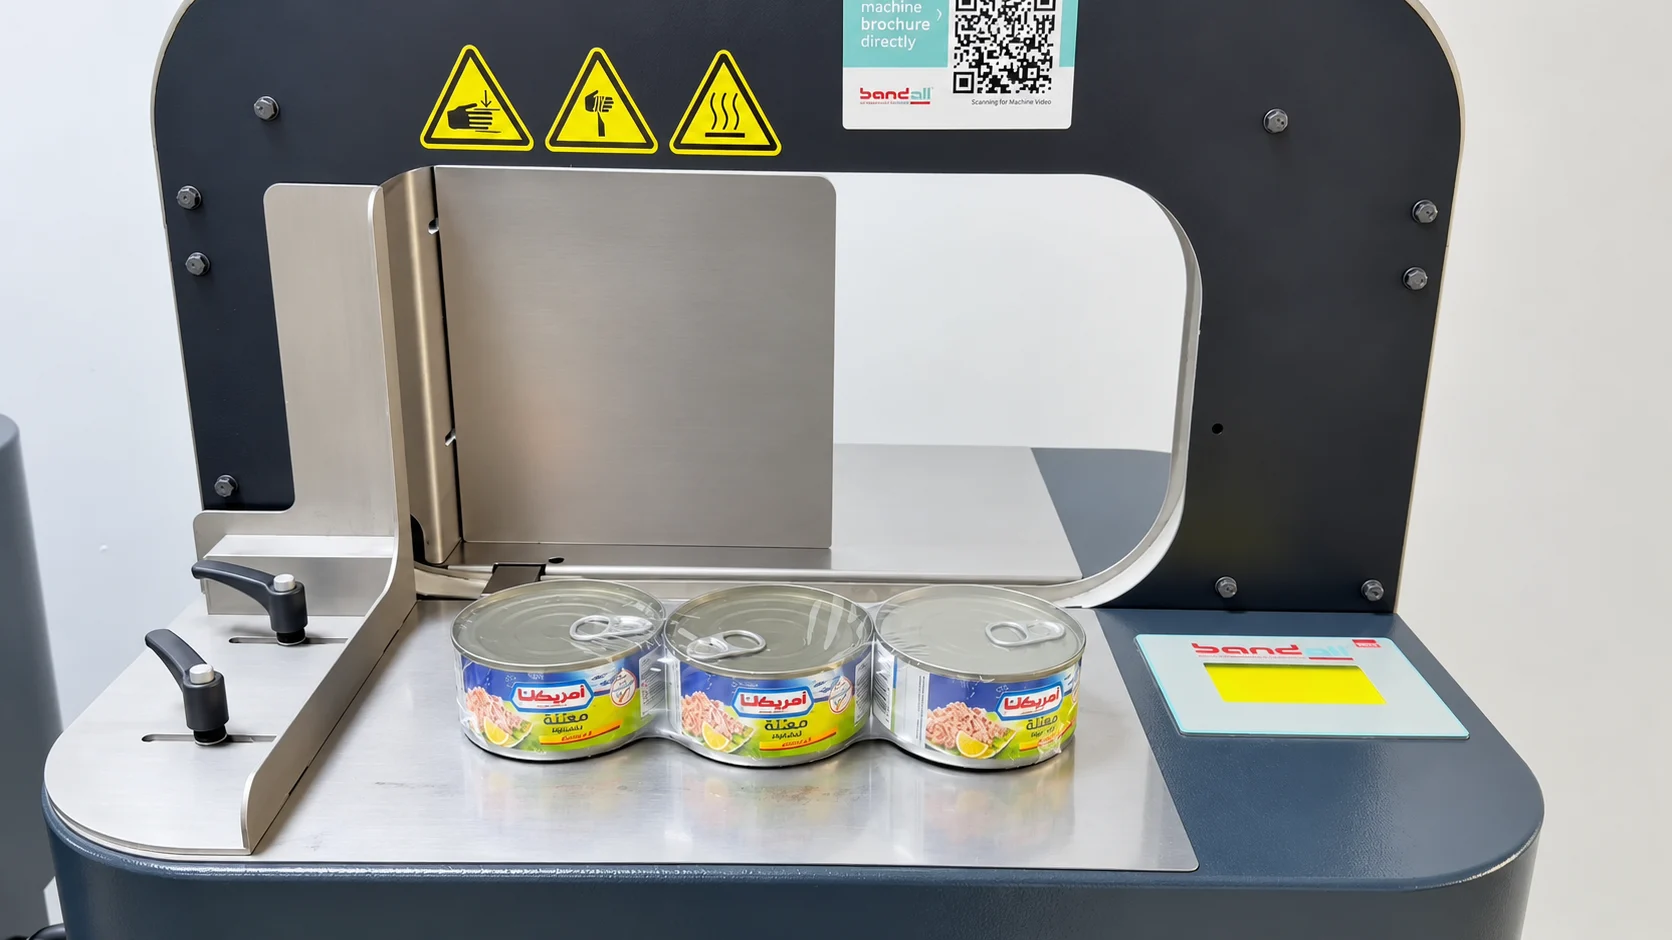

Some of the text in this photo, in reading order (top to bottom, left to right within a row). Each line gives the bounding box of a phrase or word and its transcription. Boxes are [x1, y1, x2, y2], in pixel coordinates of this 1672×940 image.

[861, 0, 922, 13] machine
[861, 17, 930, 31] brochure
[861, 34, 916, 51] directly
[859, 87, 931, 100] bandall
[971, 98, 998, 106] Scanning
[1191, 642, 1350, 657] bandall
